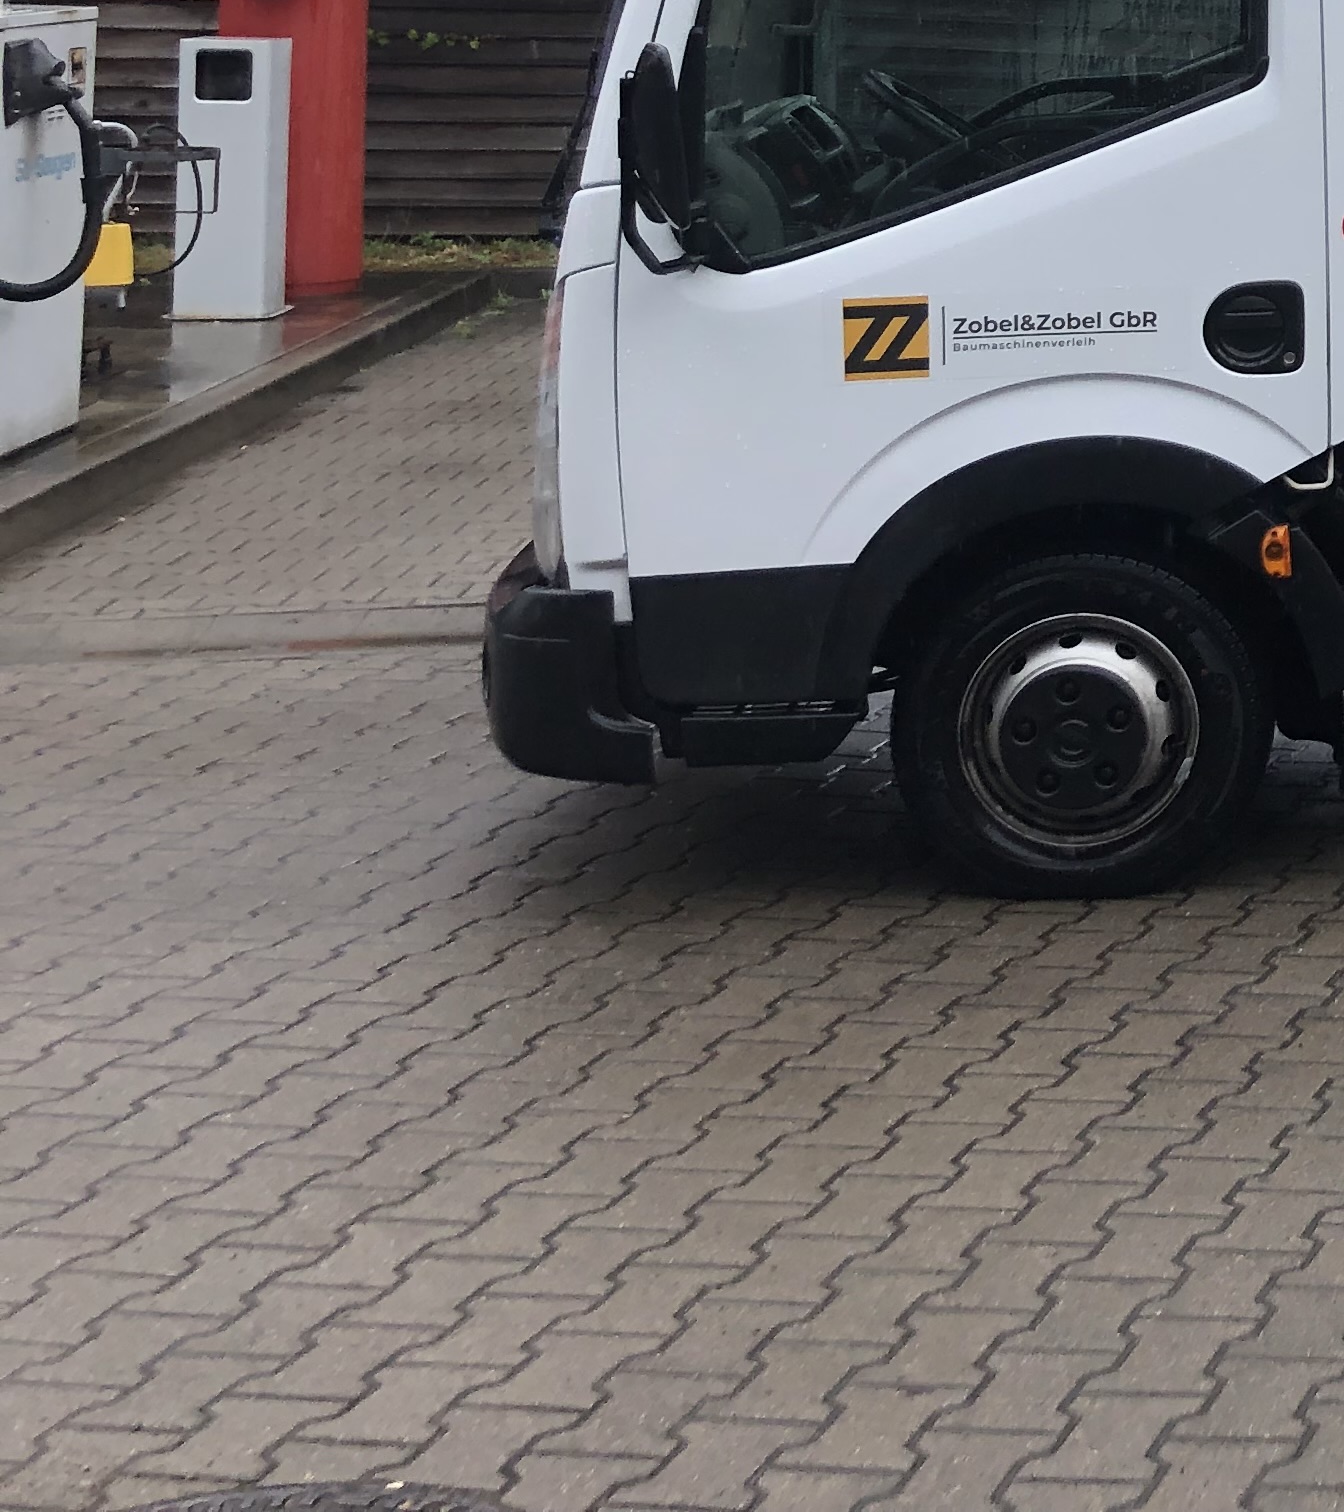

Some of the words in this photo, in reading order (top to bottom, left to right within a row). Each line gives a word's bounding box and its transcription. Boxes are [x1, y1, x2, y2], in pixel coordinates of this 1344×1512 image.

[952, 311, 1102, 335] Zobel&Zobel
[1109, 310, 1158, 328] GbR
[953, 337, 1096, 352] Baumaschinenverleih
